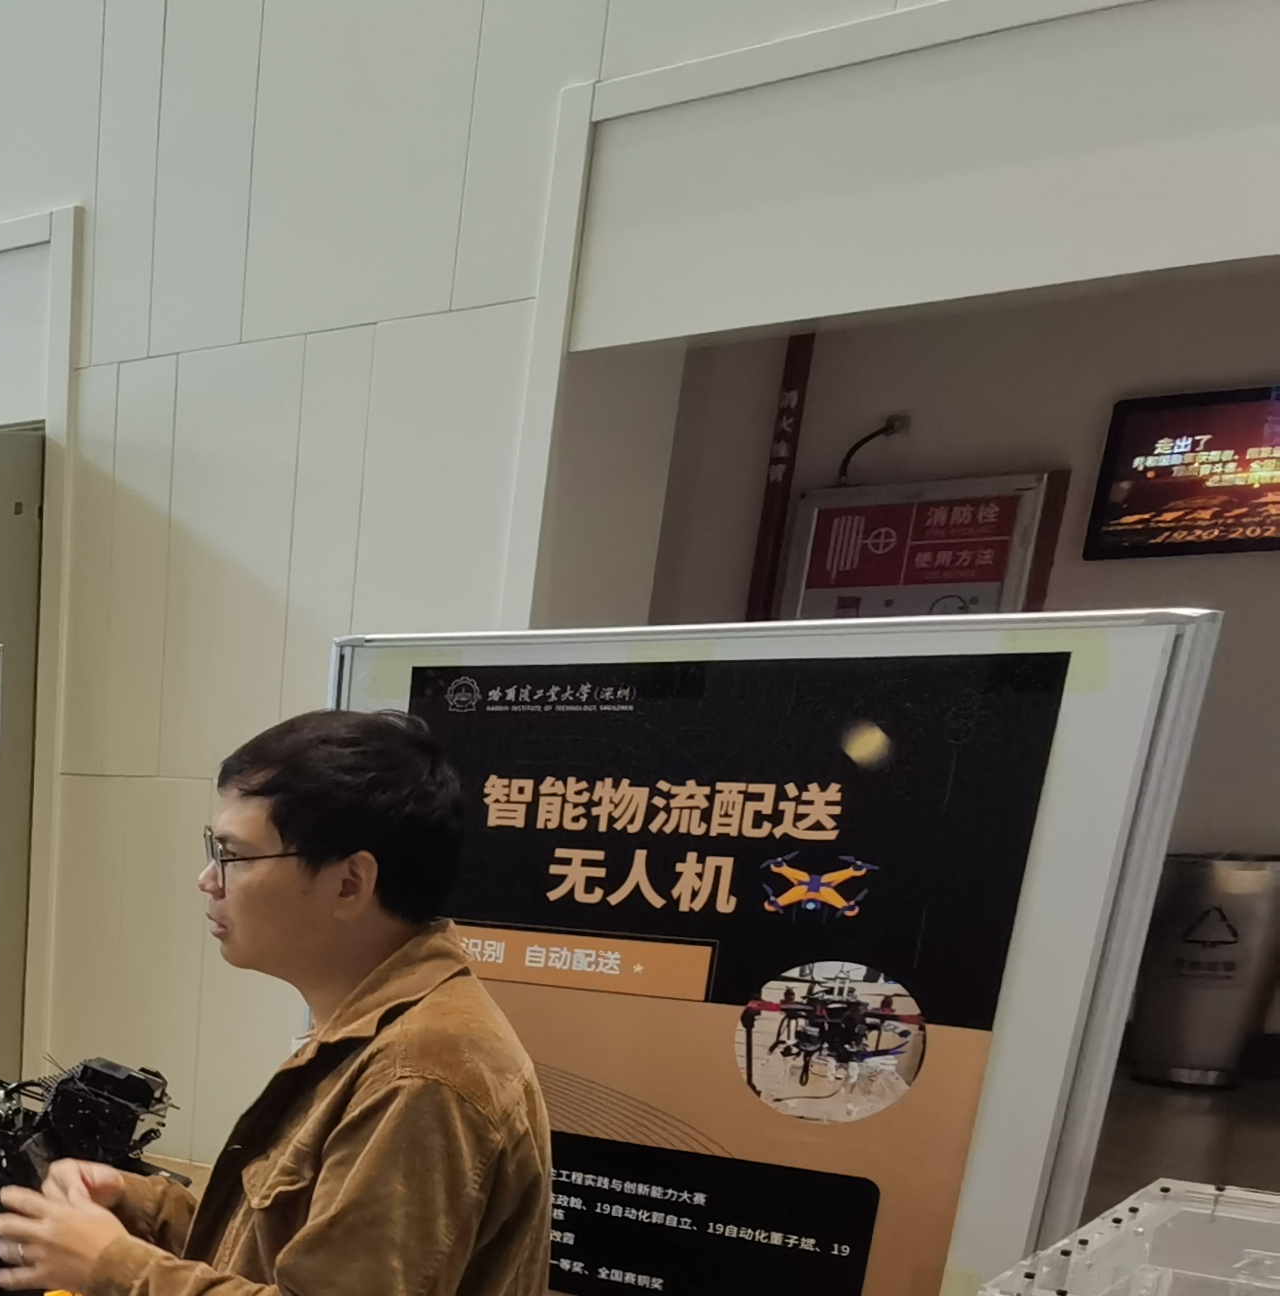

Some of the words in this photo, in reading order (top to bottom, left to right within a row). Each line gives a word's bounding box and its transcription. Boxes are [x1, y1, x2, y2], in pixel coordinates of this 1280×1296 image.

[1153, 434, 1214, 455] 走出了
[924, 503, 1001, 528] 消防栓
[483, 774, 842, 841] 智能物流配送
[546, 847, 738, 915] 无人机
[460, 936, 506, 964] 识别
[524, 944, 622, 975] 自动配送
